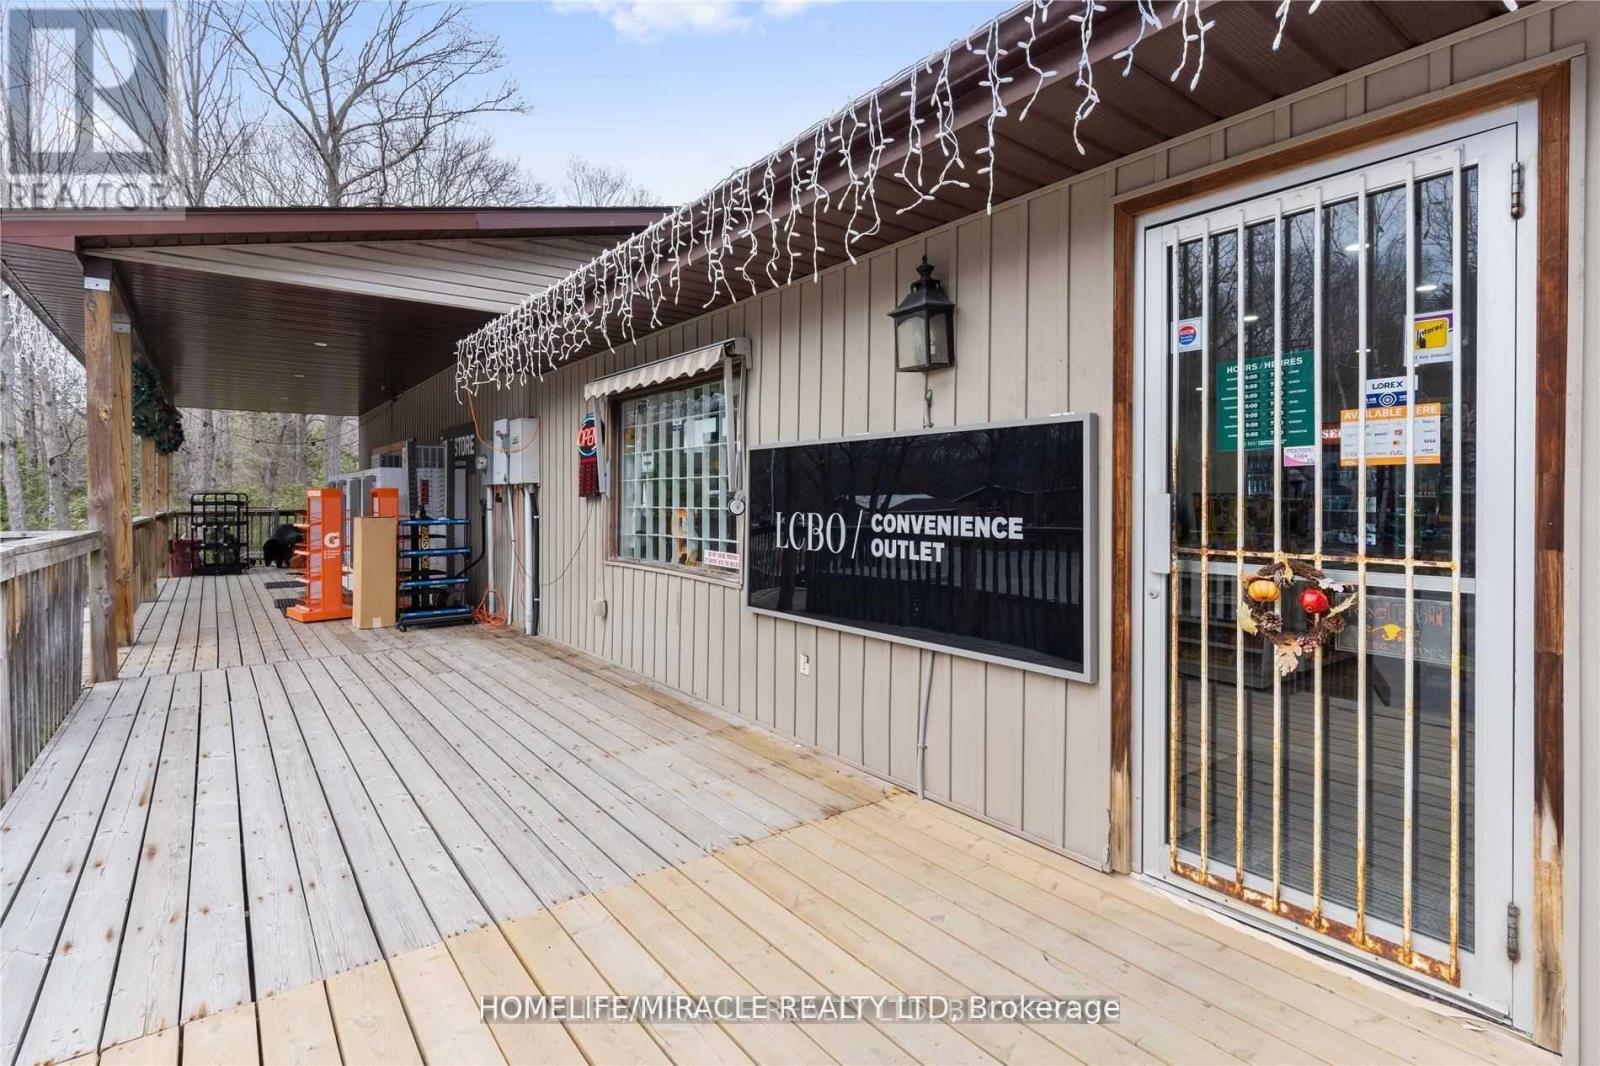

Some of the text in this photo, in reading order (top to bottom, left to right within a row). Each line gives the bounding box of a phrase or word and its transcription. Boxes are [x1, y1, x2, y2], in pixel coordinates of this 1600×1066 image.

[1226, 363, 1258, 374] HORS
[1372, 381, 1403, 390] LOREX
[454, 434, 475, 457] STORE
[776, 511, 846, 553] LCBO
[871, 513, 1024, 540] CONVENIENCE
[871, 538, 945, 562] OUTLET
